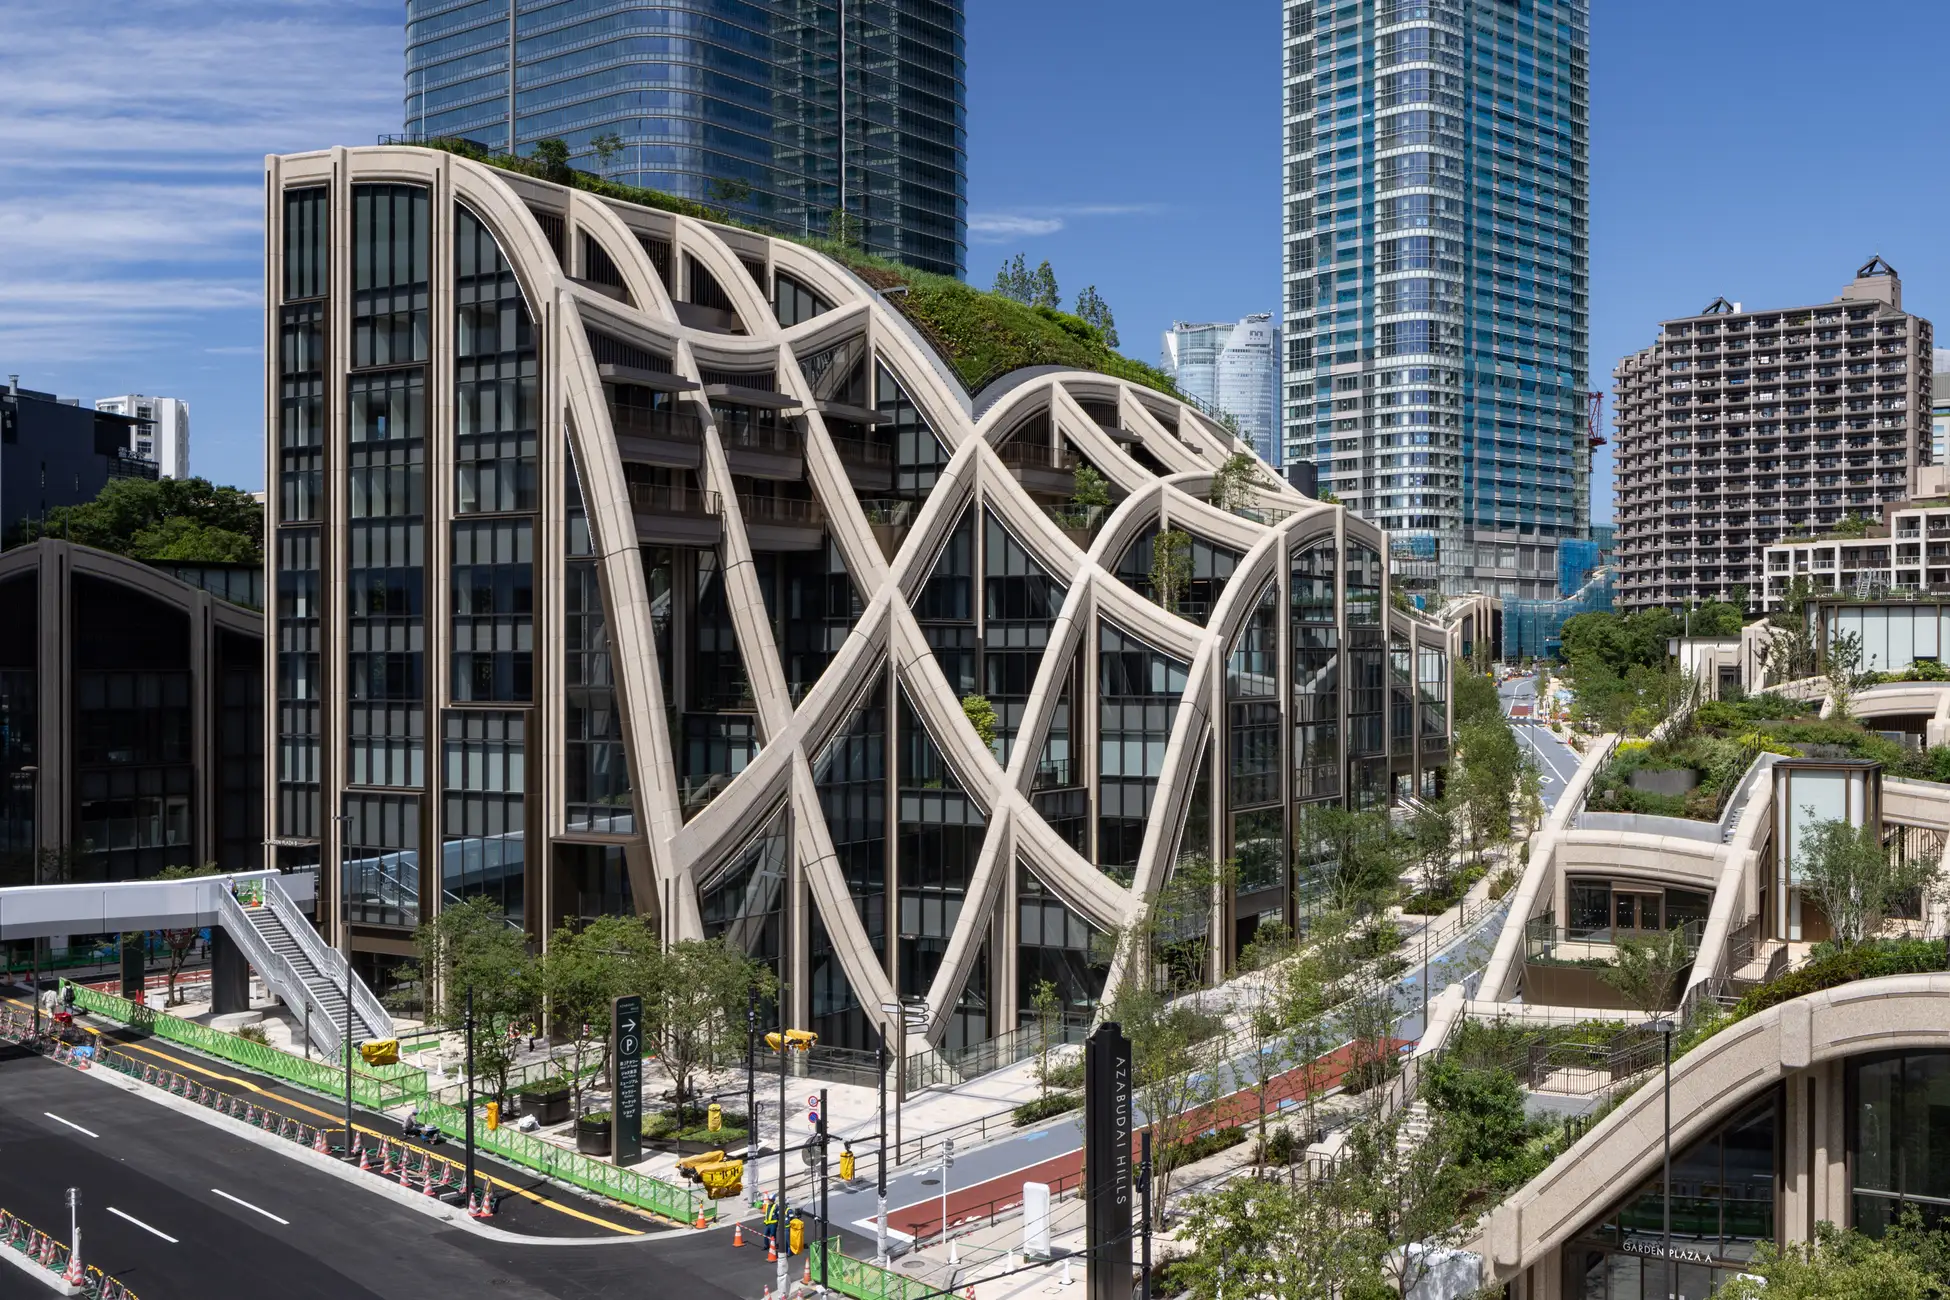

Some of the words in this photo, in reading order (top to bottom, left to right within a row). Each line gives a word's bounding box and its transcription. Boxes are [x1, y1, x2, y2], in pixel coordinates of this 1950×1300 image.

[626, 1038, 633, 1052] P
[1116, 1057, 1126, 1147] AZABUDAI
[1116, 1155, 1127, 1204] HILLS
[1622, 1242, 1664, 1257] GARDEN
[1669, 1249, 1702, 1262] PLAZA
[1704, 1254, 1713, 1264] A
